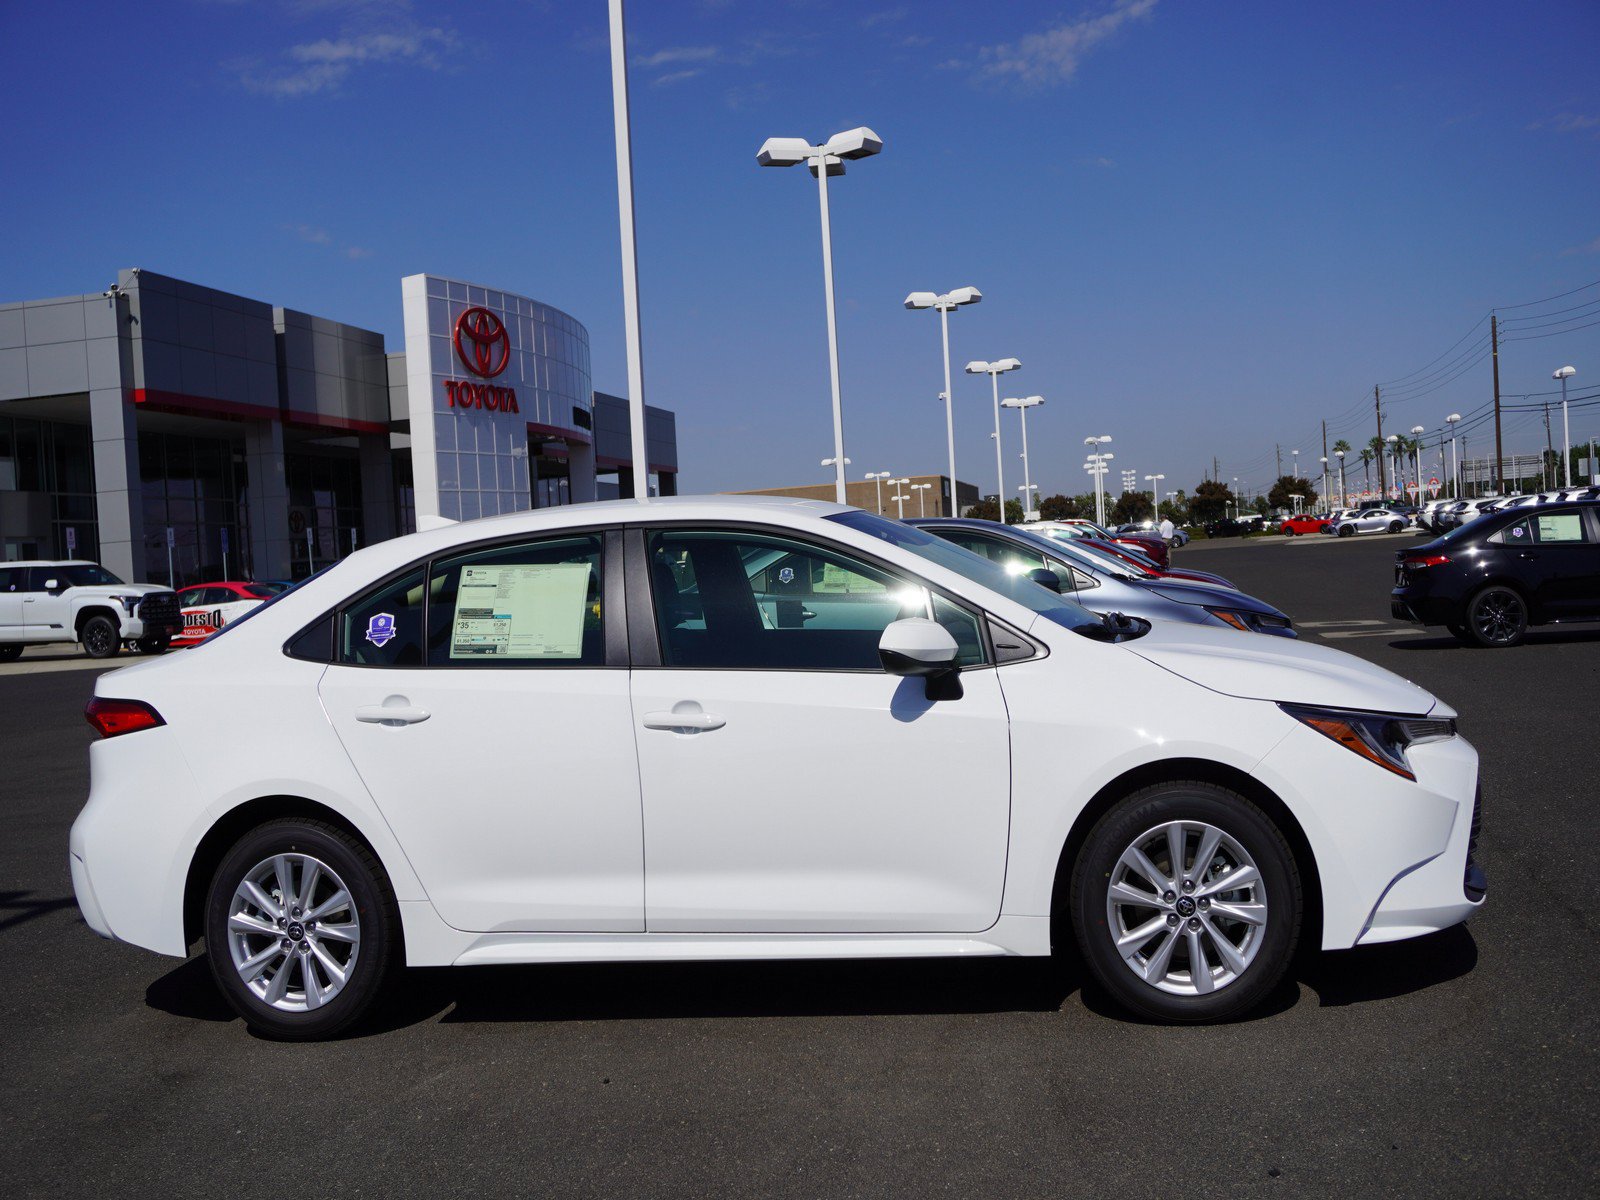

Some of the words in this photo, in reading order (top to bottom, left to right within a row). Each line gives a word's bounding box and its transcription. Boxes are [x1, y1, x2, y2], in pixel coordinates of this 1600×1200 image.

[443, 380, 519, 413] TOYOTA
[183, 609, 222, 629] DESTO
[460, 621, 470, 629] 35
